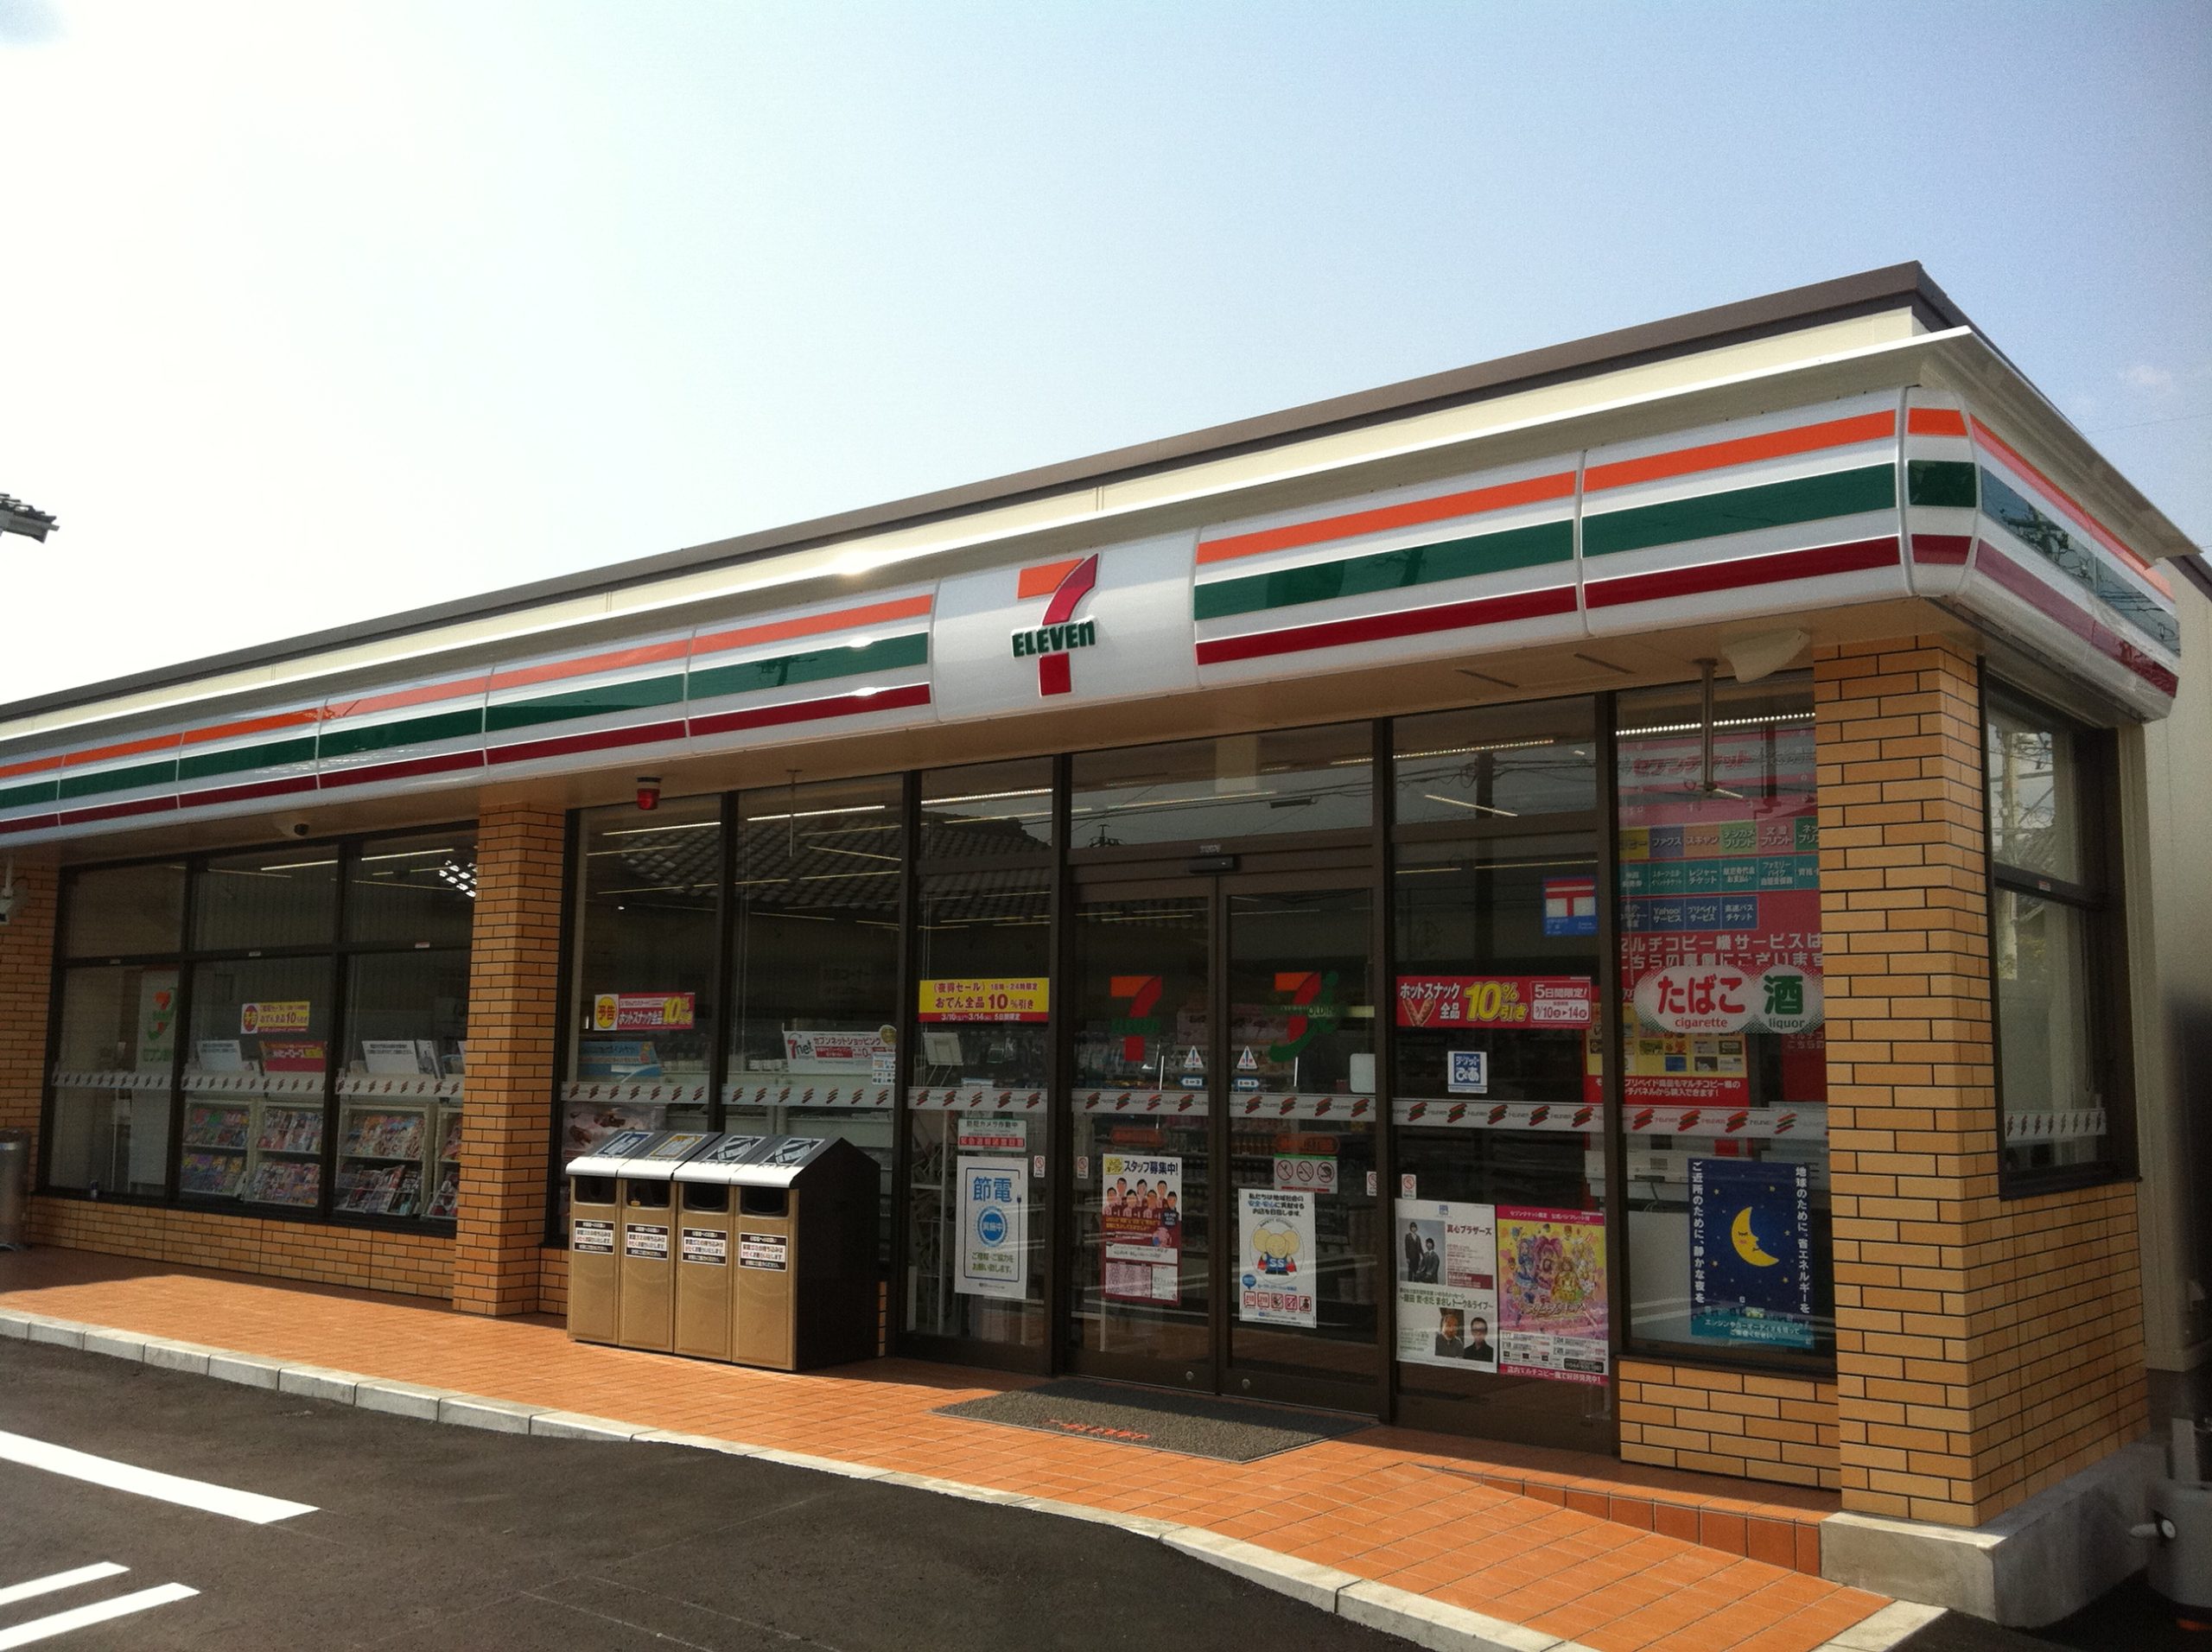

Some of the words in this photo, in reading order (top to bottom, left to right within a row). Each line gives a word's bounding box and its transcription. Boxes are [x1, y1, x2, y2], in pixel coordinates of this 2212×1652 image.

[1018, 553, 1098, 696] 7
[1535, 984, 1588, 999] 5日間限定!
[1658, 974, 1745, 1014] たばこ
[1764, 975, 1803, 1015] 酒
[1400, 982, 1460, 1001] ホットスナック
[1440, 1002, 1460, 1020] 全品
[598, 1005, 615, 1020] 予告
[1675, 1018, 1728, 1028] cigarette
[1769, 1018, 1805, 1029] liquor
[1455, 1066, 1480, 1083] ぴあ
[1124, 1160, 1179, 1176] スタッフ募集中!
[973, 1176, 1012, 1203] 節電
[1446, 1223, 1492, 1236] 真心ブラザーズ
[1692, 1161, 1706, 1304] ご近所のために、静かな夜を
[1268, 1258, 1285, 1268] SS
